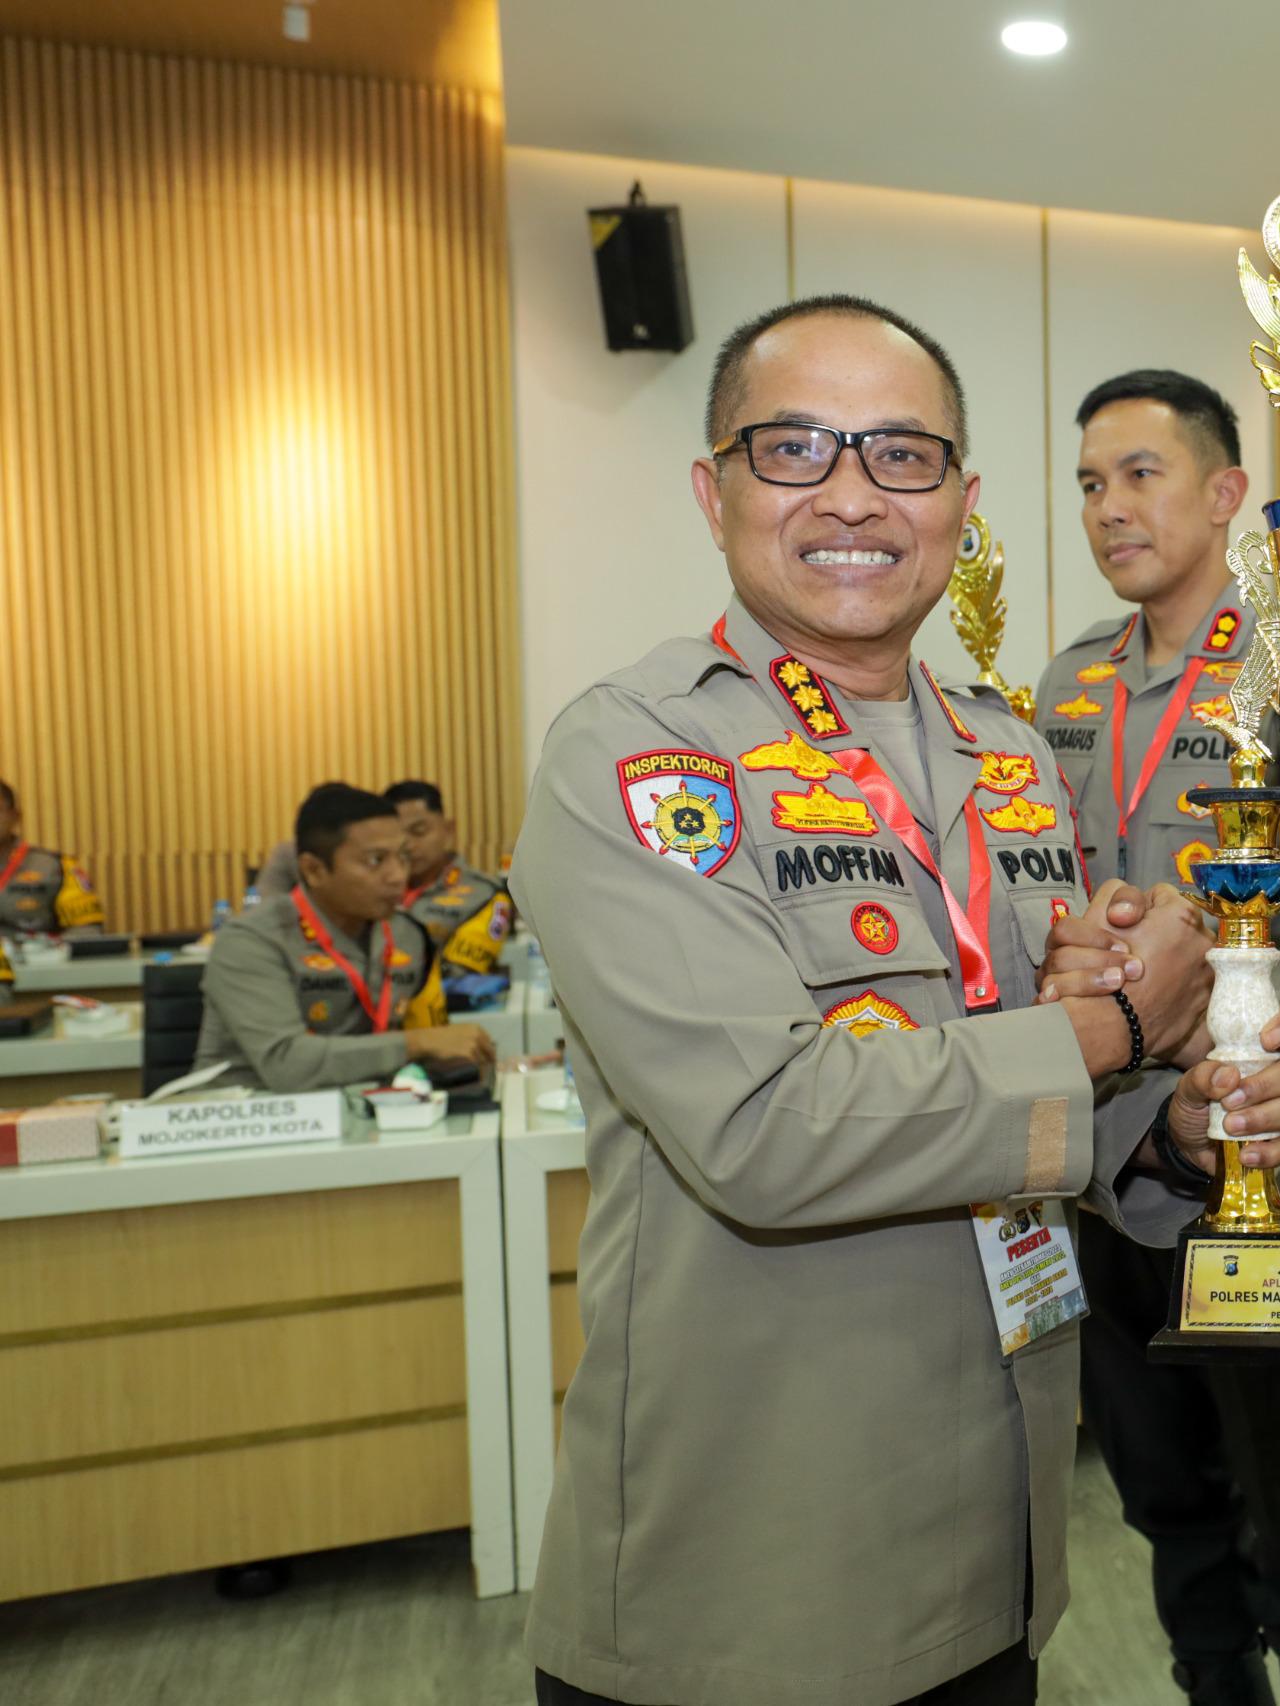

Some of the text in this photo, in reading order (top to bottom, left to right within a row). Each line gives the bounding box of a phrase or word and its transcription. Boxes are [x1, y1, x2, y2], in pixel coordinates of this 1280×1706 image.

[1172, 736, 1238, 760] POL
[624, 753, 729, 780] INSPEKTORAT
[775, 844, 905, 892] MOFFAN
[996, 847, 1076, 886] POLRI
[168, 1100, 296, 1125] KAPOLRES
[138, 1118, 324, 1146] MOJOKERTO KOTA
[1210, 1291, 1258, 1303] POLRES
